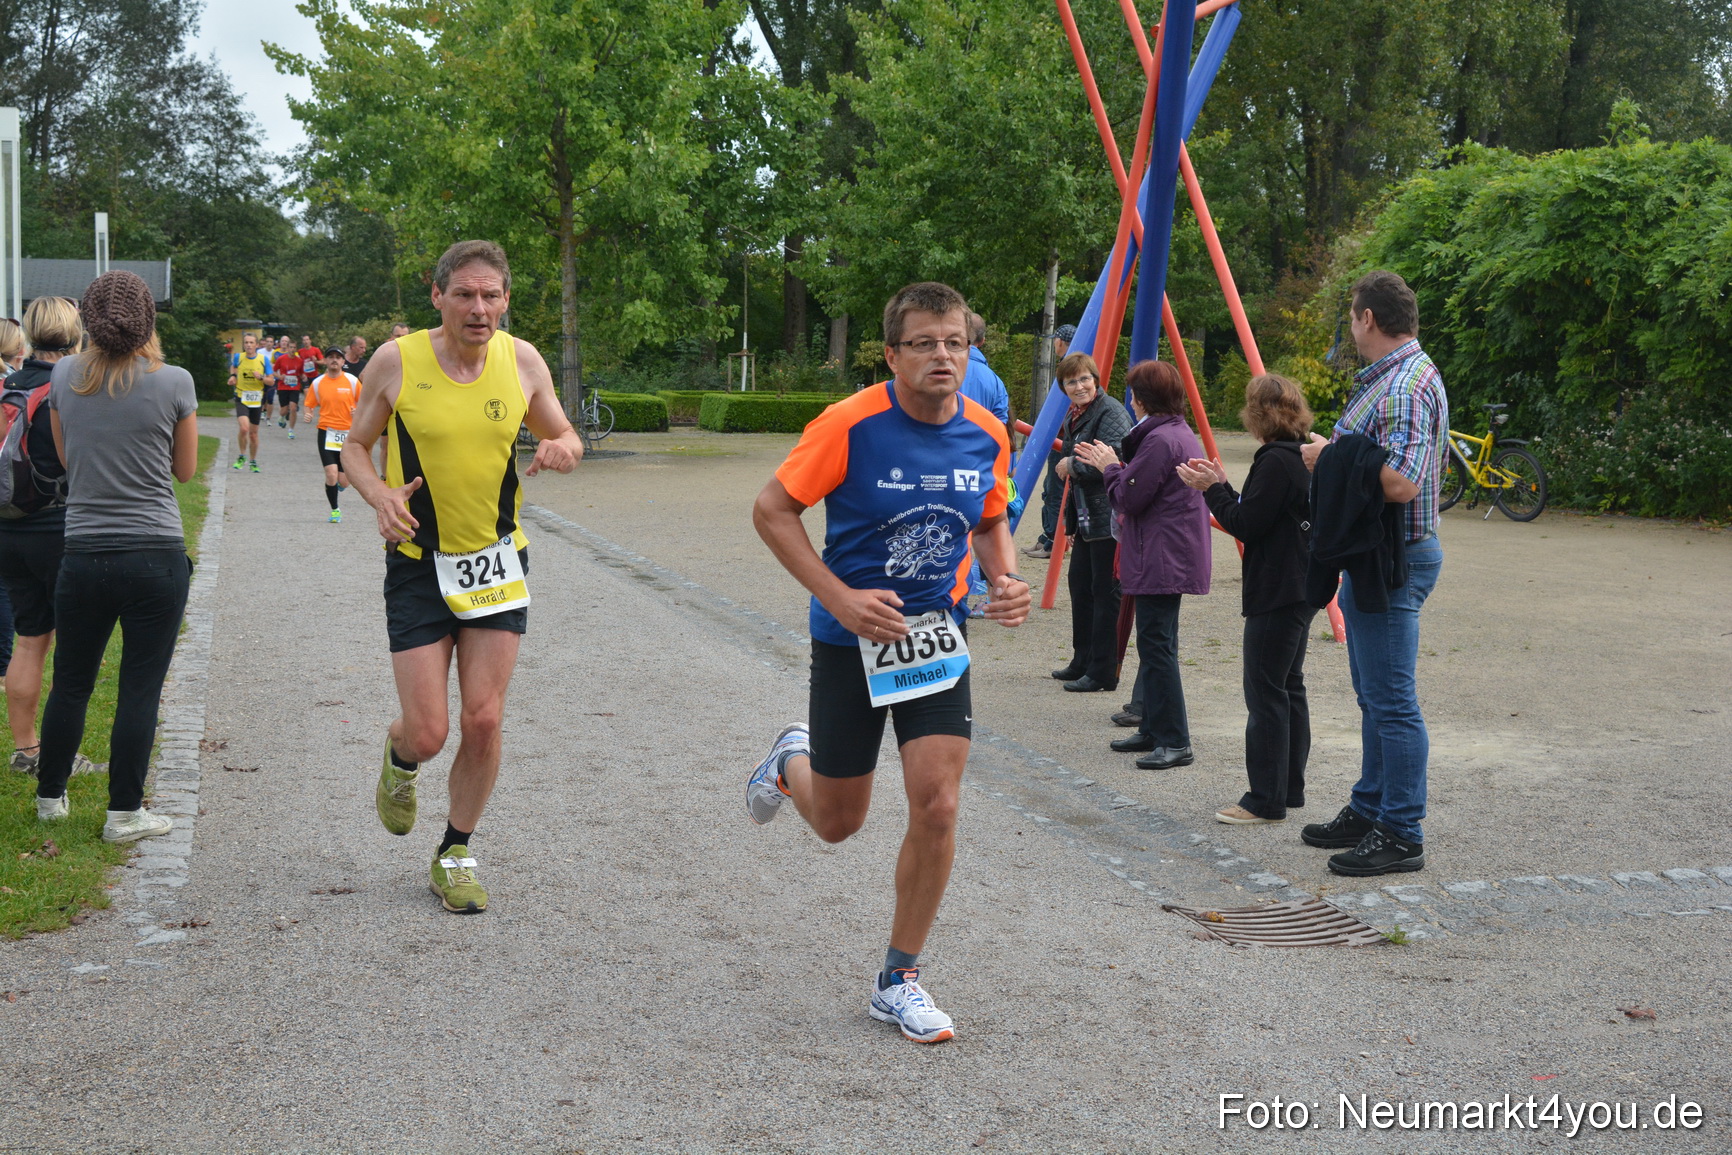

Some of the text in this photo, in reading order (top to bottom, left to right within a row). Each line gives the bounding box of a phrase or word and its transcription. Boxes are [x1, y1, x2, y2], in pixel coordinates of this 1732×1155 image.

[877, 480, 916, 491] Ensinger
[887, 504, 926, 526] Heilbronner
[456, 551, 507, 589] 324
[470, 589, 507, 606] Harald
[871, 626, 958, 669] 2036
[893, 664, 948, 689] Michael
